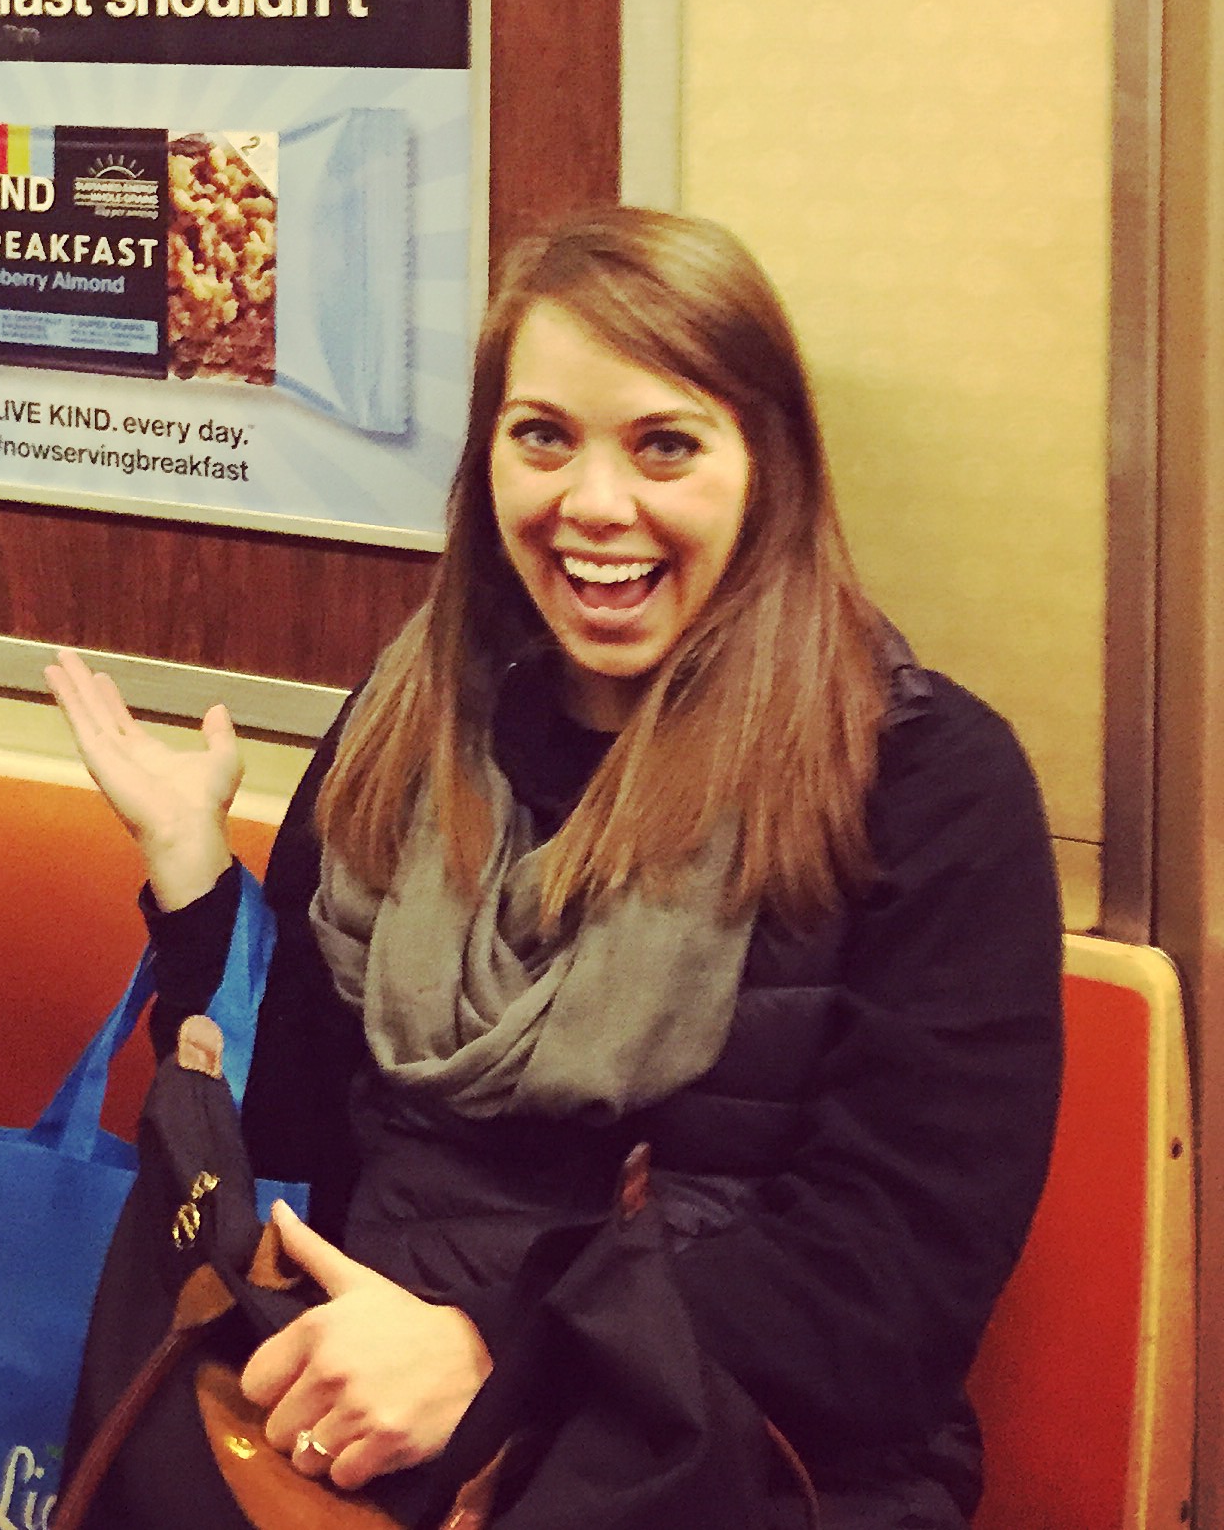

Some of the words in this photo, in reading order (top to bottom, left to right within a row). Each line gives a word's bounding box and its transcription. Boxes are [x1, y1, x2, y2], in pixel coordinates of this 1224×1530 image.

[51, 271, 125, 295] Almond
[49, 404, 117, 433] KIND.
[123, 416, 191, 444] every
